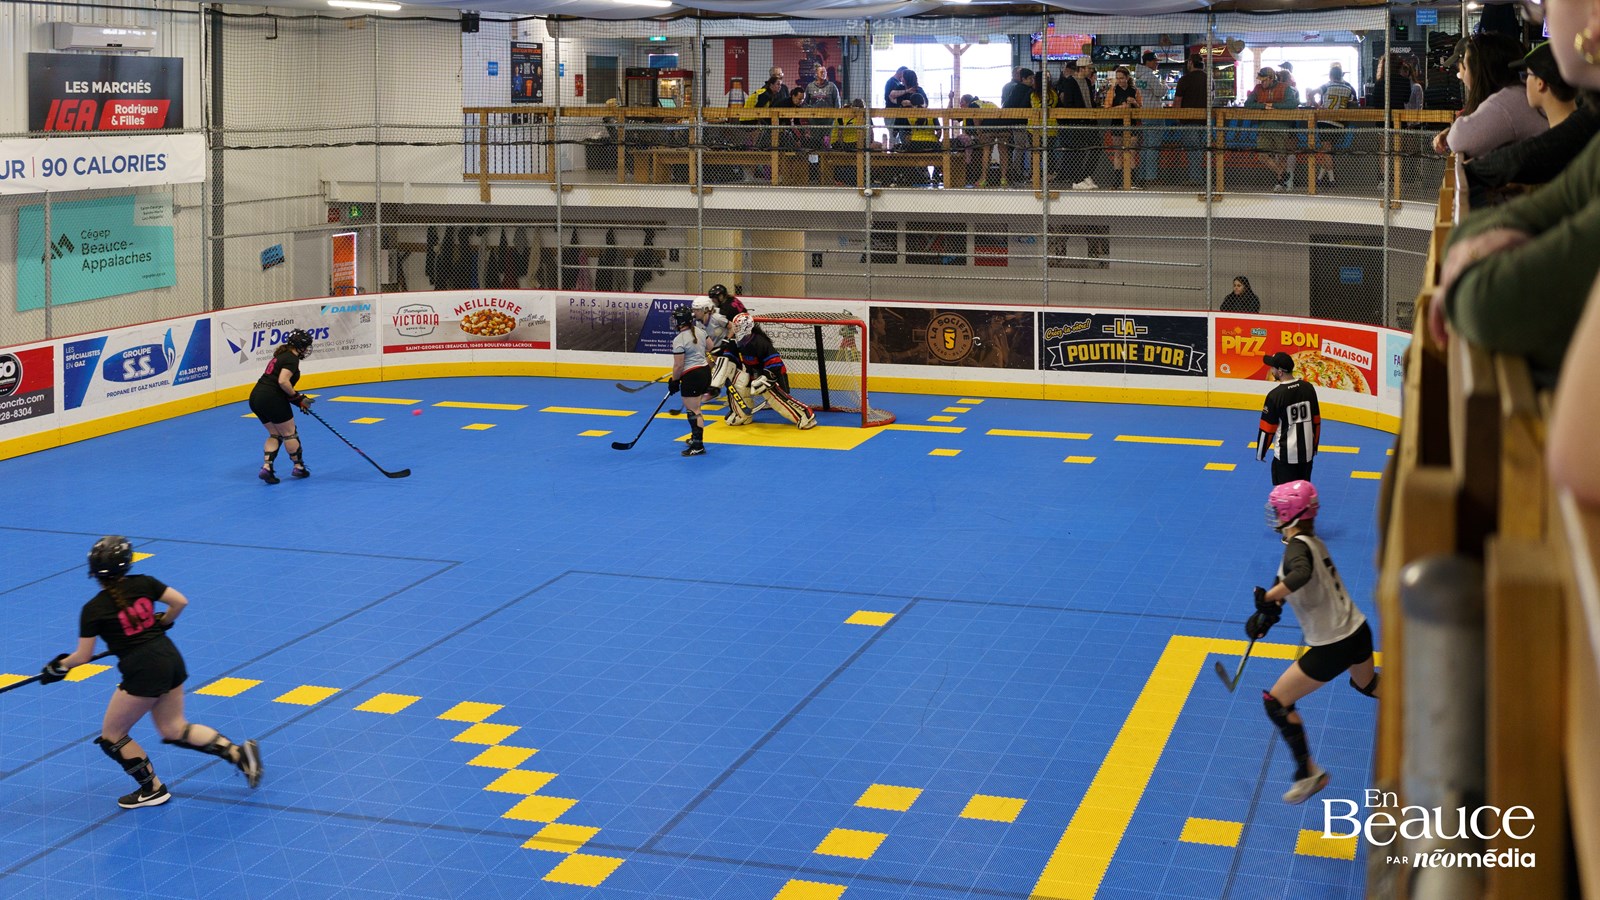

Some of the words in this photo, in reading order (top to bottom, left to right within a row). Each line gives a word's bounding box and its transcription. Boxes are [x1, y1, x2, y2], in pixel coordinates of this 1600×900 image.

[65, 81, 89, 93] LES
[92, 80, 151, 94] MARCHÉS
[44, 99, 98, 131] IGA
[115, 104, 158, 115] Rodrigue
[111, 116, 118, 126] &
[119, 116, 145, 126] Filles
[42, 157, 67, 177] 90
[80, 228, 110, 240] Cégep
[81, 239, 134, 256] Beauce-
[82, 251, 152, 274] Appalaches
[331, 304, 371, 313] DAIKIN
[454, 297, 523, 316] MEILLEURE
[569, 298, 601, 308] P.R.S.
[606, 300, 649, 310] Jacques
[253, 318, 294, 330] Réfrigération
[392, 314, 439, 327] VICTORIA
[1116, 320, 1135, 335] LA
[250, 329, 265, 352] JF
[270, 327, 330, 346] Deers
[930, 327, 939, 339] LA
[1281, 331, 1319, 348] BON
[123, 346, 151, 359] GROUPE
[1222, 335, 1266, 357] PIZZ
[66, 349, 100, 362] SPÉCIALISTES
[1067, 343, 1138, 362] POUTINE
[1143, 346, 1184, 366] D'OR
[1324, 343, 1332, 354] À
[1332, 349, 1370, 366] MAISON
[74, 359, 86, 368] GAZ
[123, 355, 155, 380] S.S.
[106, 387, 130, 398] PROPANE
[138, 384, 149, 392] GAZ
[149, 380, 171, 390] NATUREL
[0, 393, 45, 410] oncrb.com
[0, 406, 33, 422] 28-8304
[1290, 403, 1309, 422] 90
